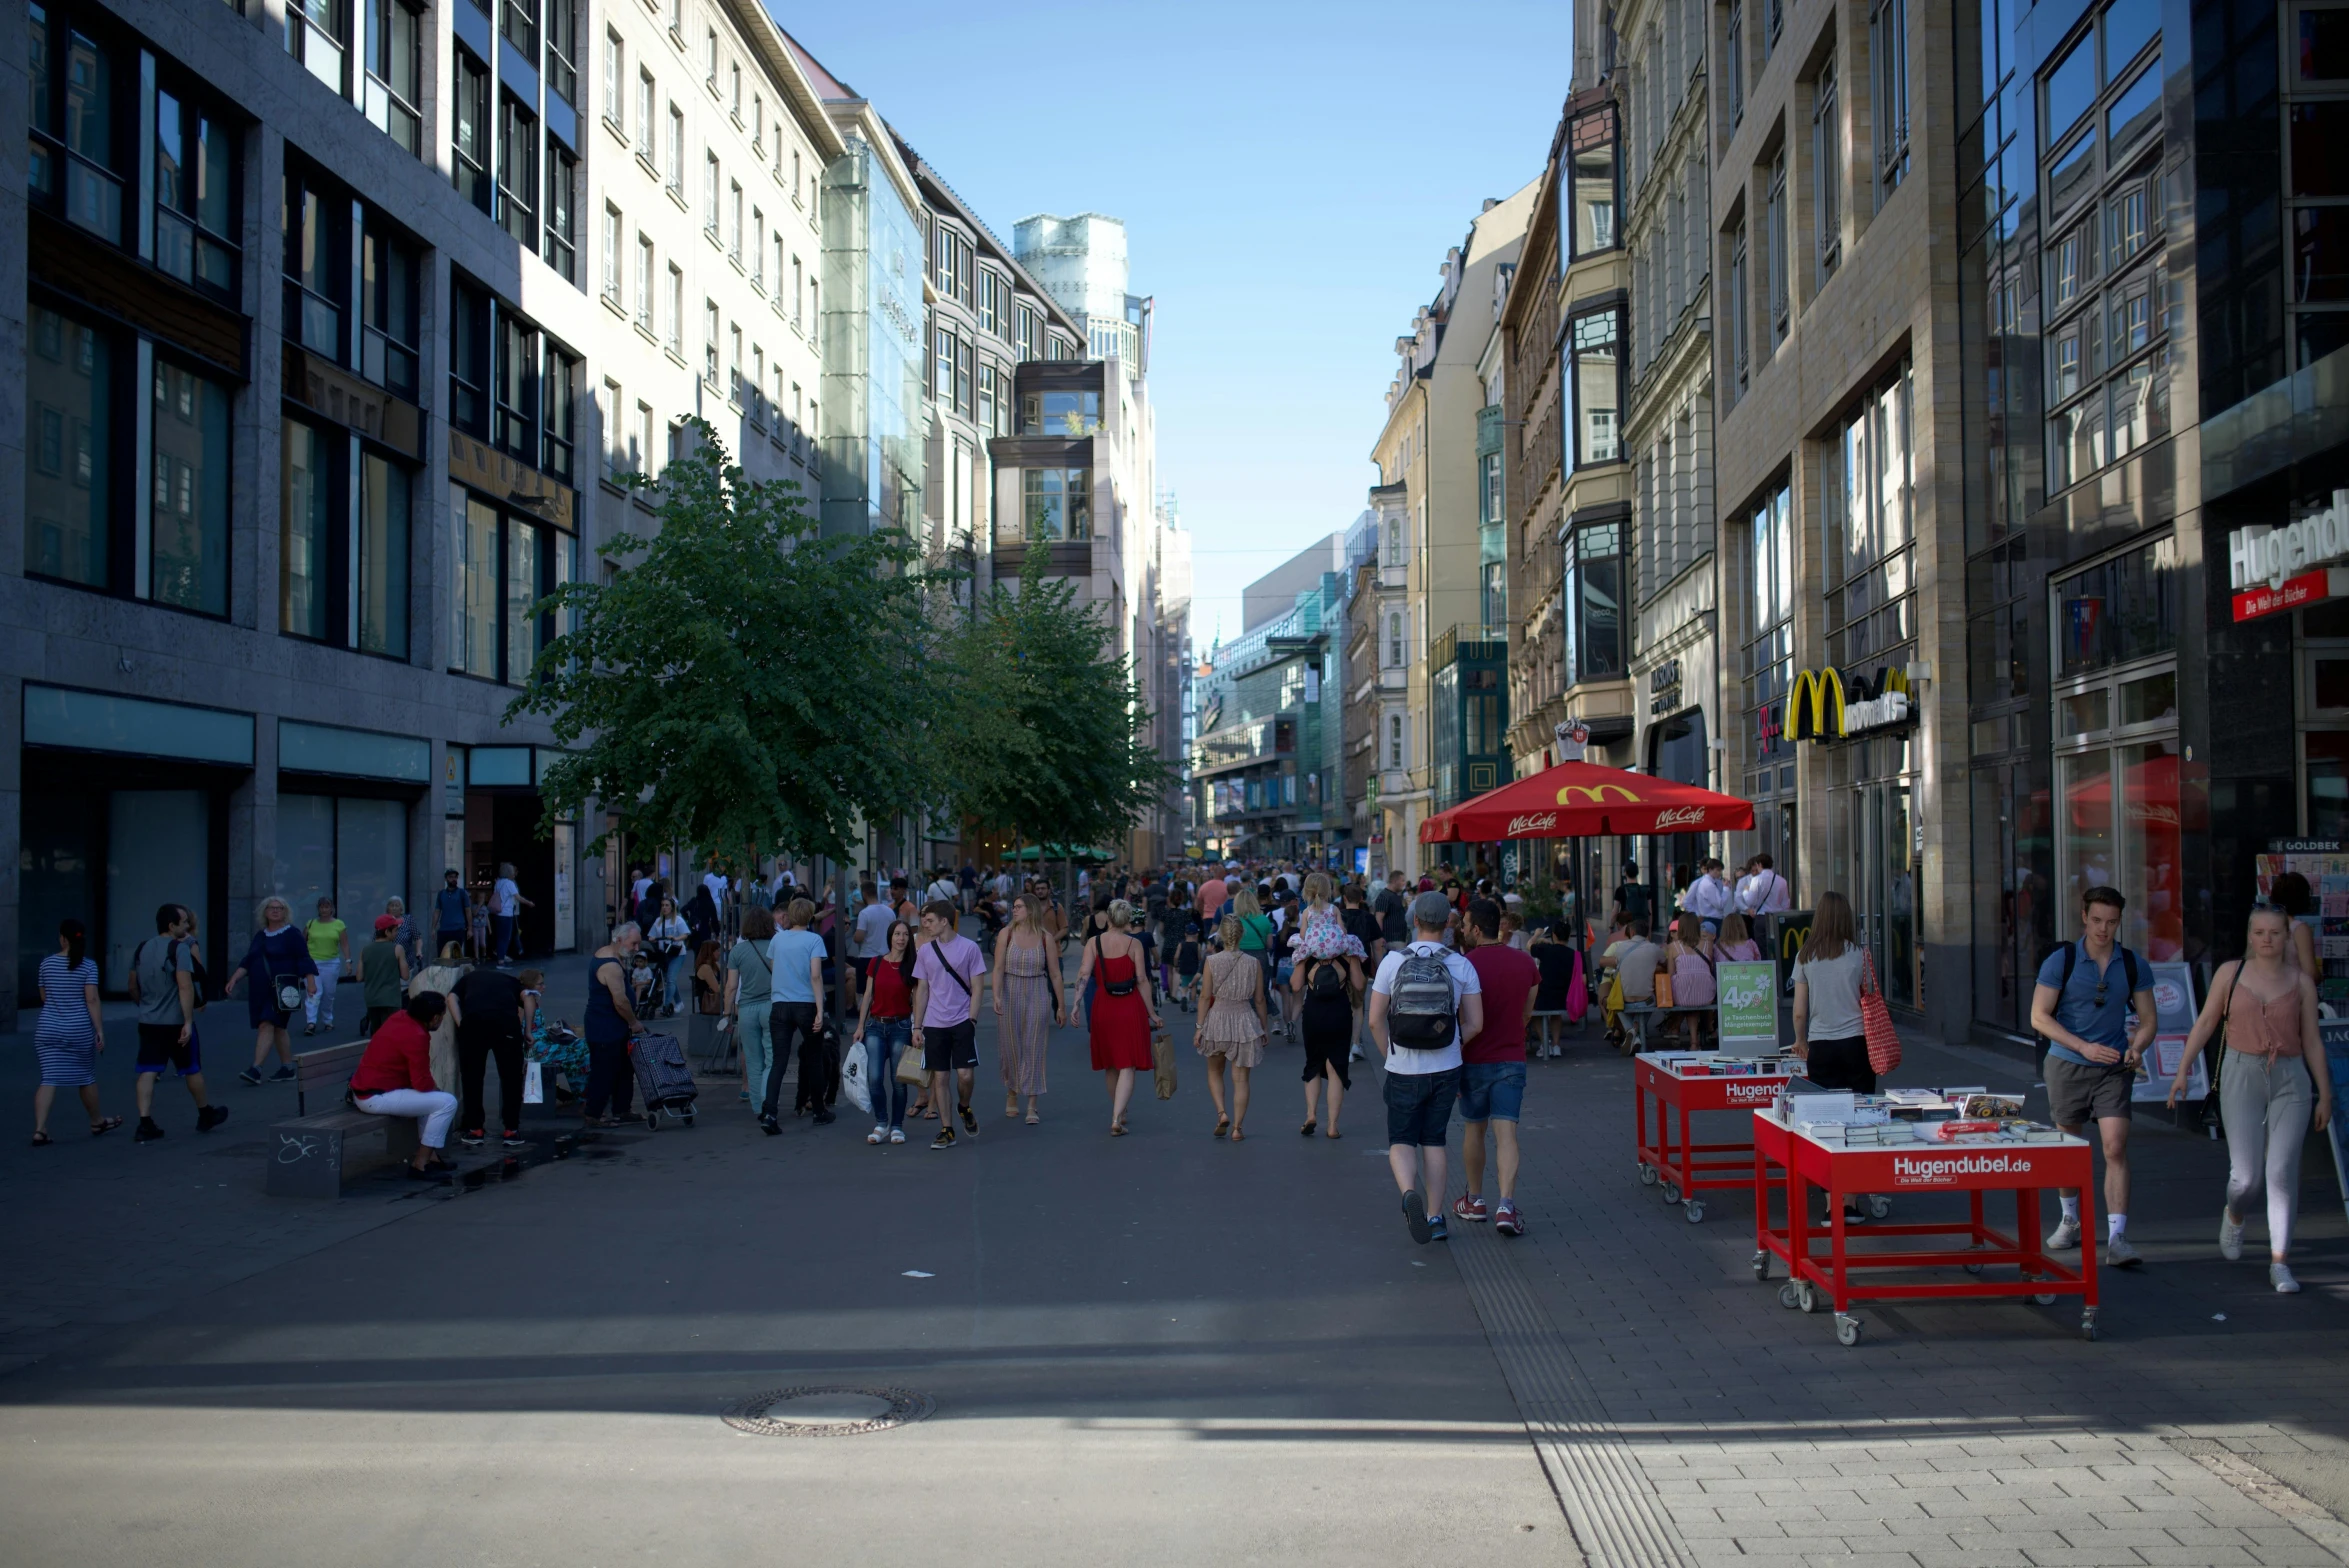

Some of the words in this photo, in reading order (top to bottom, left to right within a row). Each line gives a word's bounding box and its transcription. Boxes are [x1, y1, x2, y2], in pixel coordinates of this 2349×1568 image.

[2245, 599, 2257, 615] Die
[2257, 592, 2272, 611] Welt
[2272, 593, 2284, 608] der
[2284, 584, 2308, 604] Bücher
[1507, 811, 1557, 836] McCafé
[1655, 806, 1706, 829] McCafé
[2286, 841, 2340, 851] GOLDBEK
[1723, 973, 1739, 982] jetzt
[1732, 1013, 1773, 1021] Taschenbuch
[1894, 1155, 2032, 1178] Hugendubel.de
